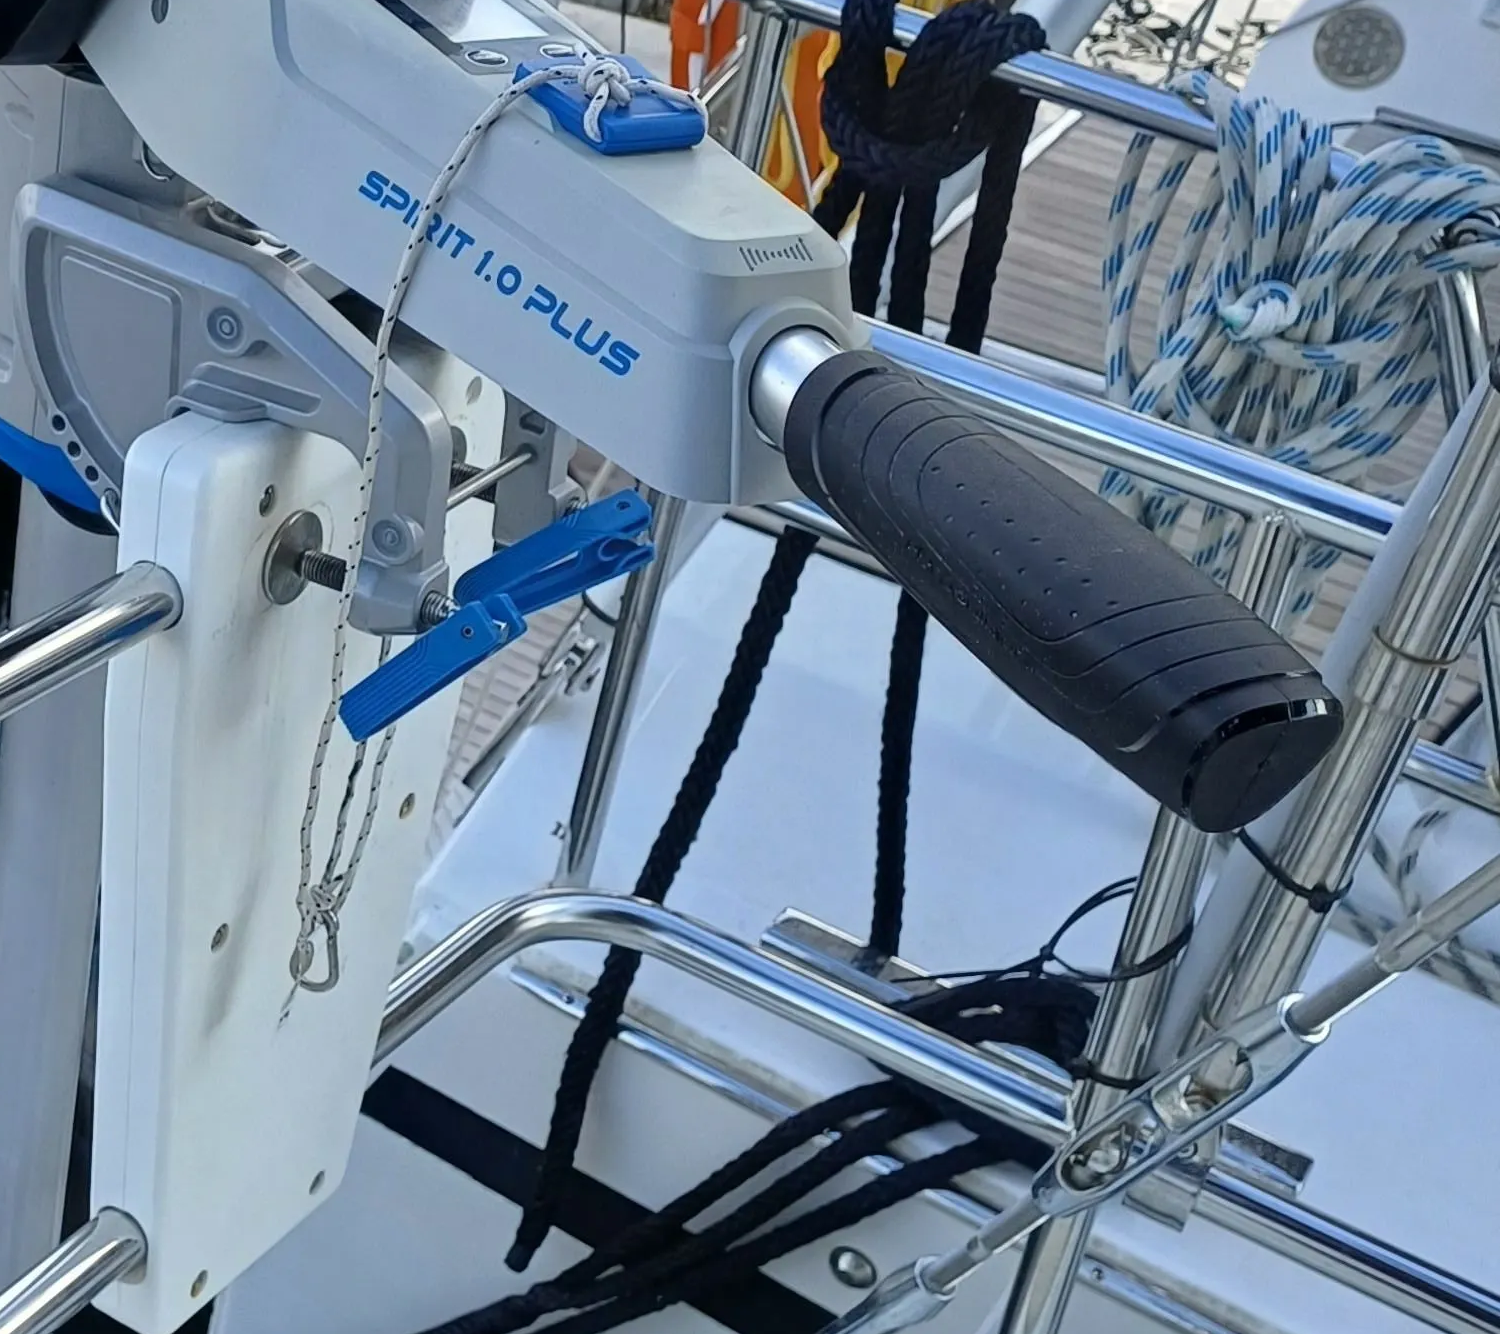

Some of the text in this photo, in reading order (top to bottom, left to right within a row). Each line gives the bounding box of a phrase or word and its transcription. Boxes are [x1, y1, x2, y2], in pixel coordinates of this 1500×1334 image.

[358, 170, 641, 377] SPIRIT 1.0 PLUS
